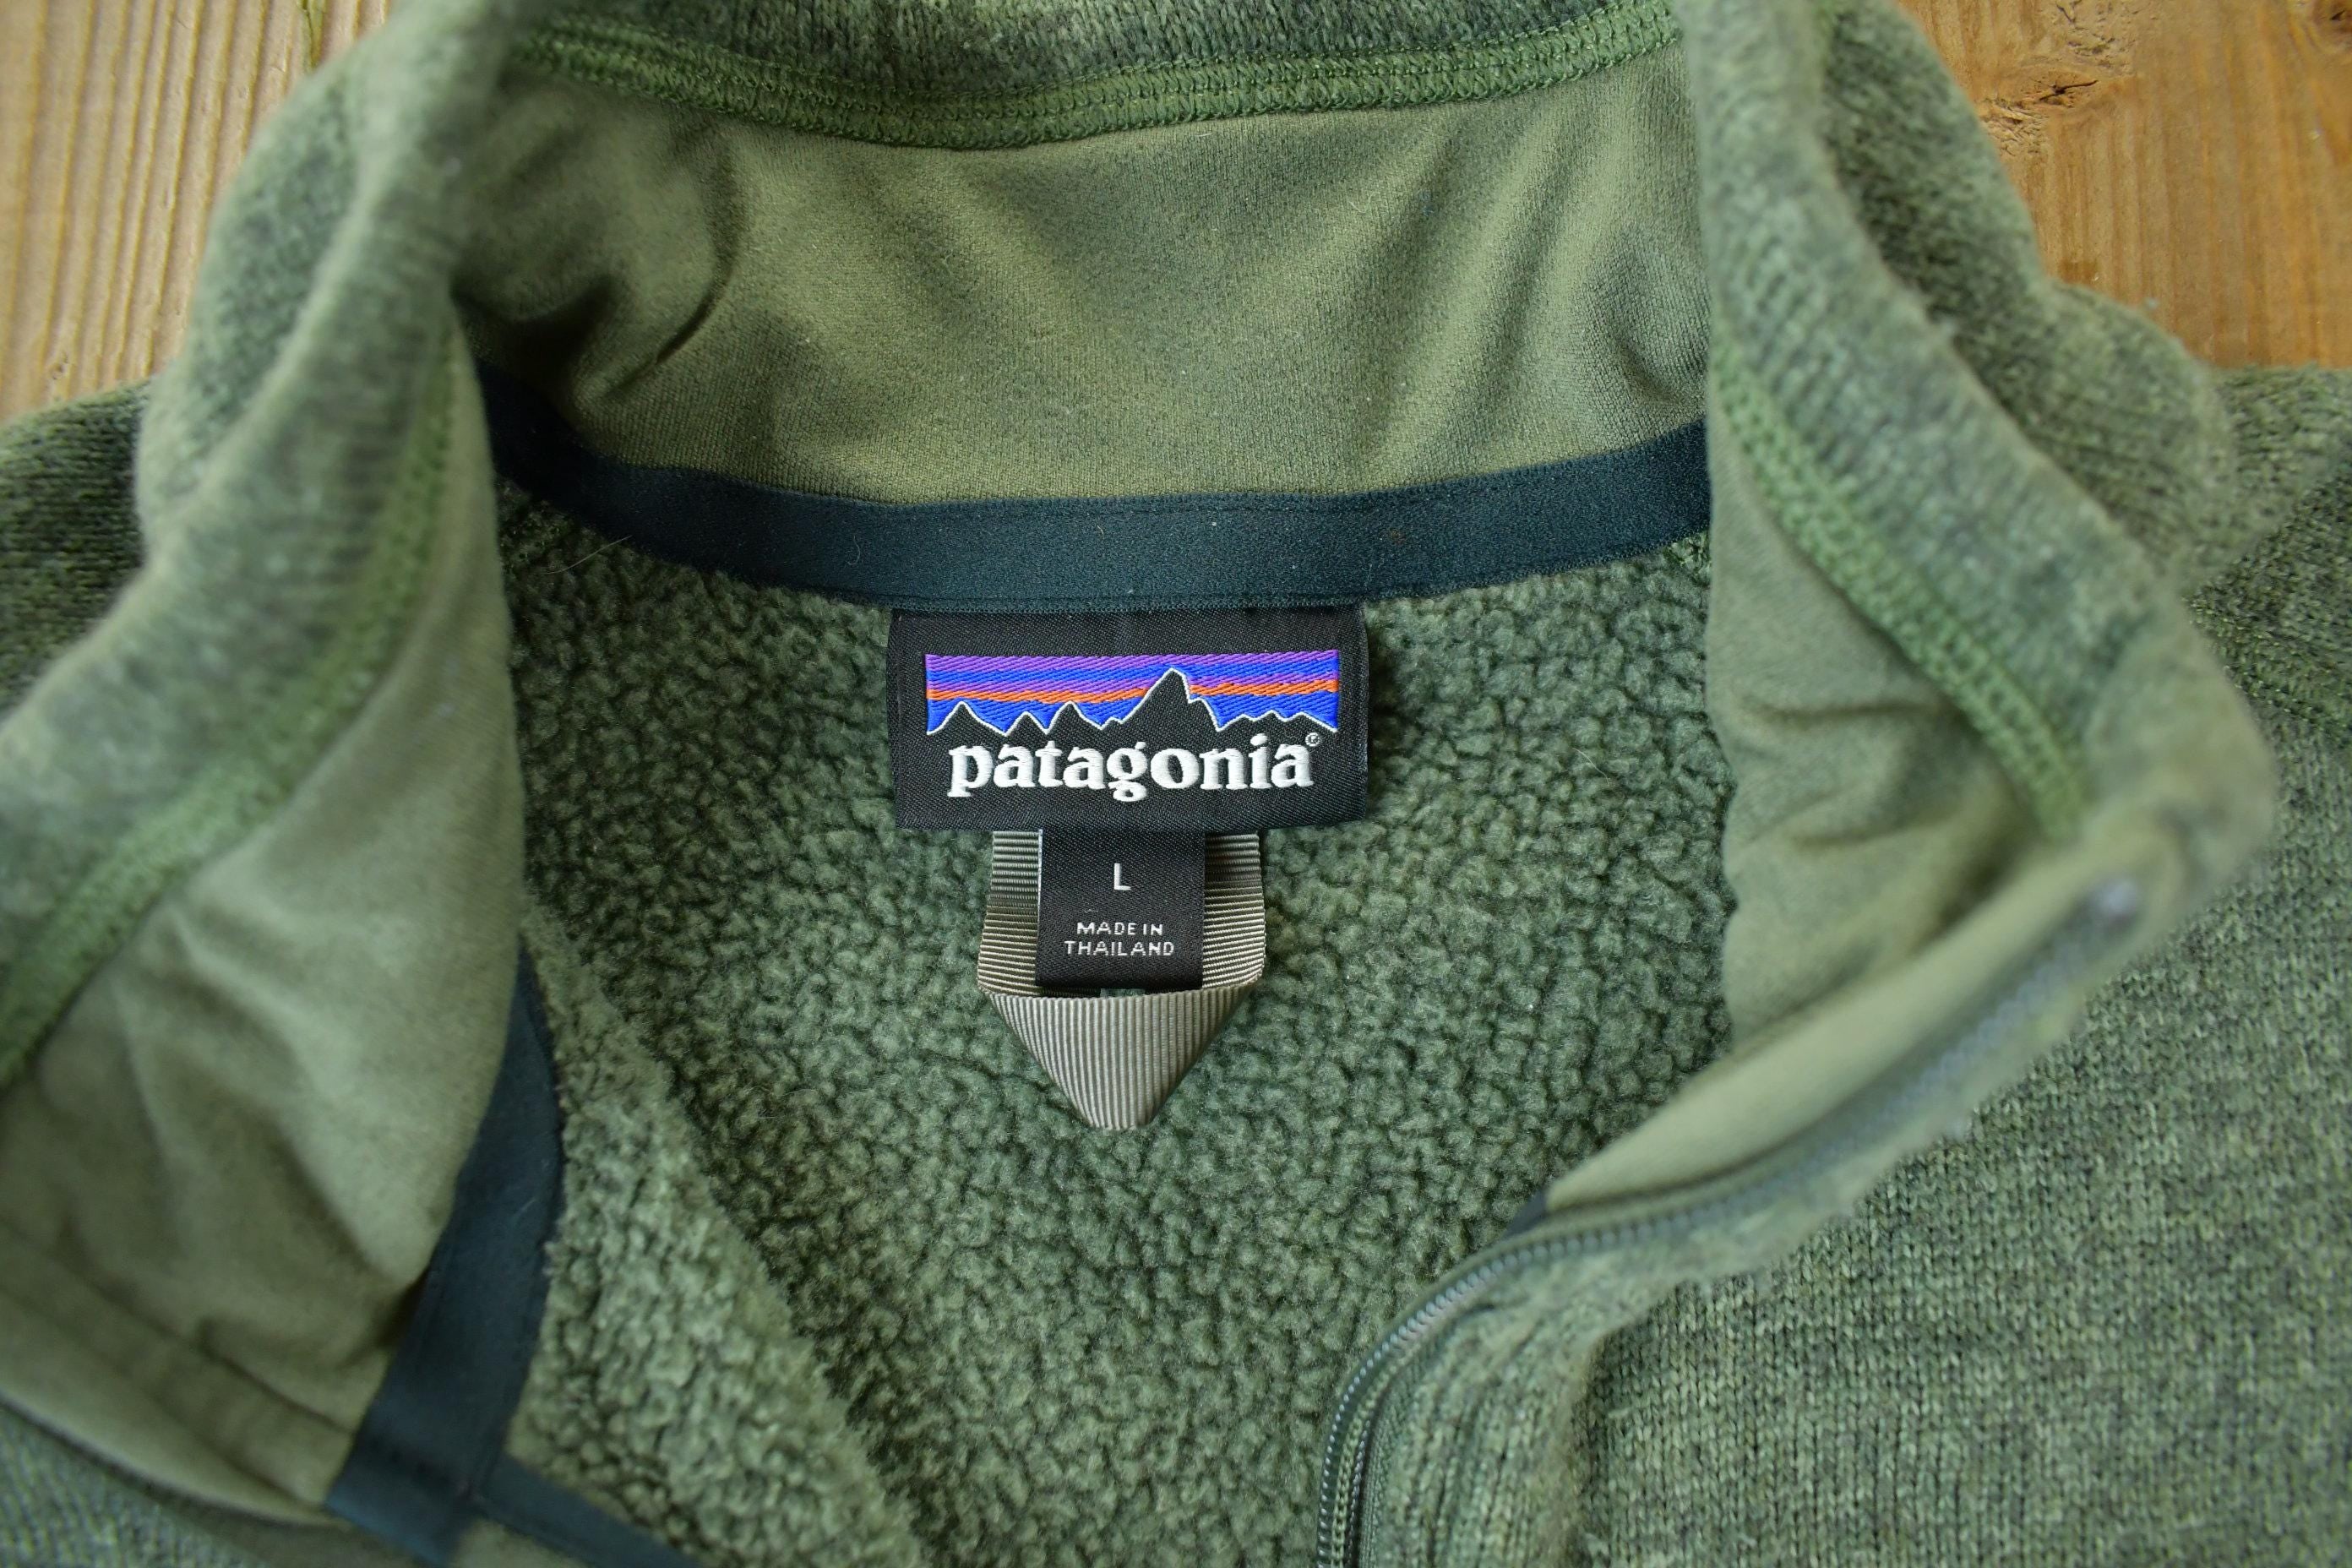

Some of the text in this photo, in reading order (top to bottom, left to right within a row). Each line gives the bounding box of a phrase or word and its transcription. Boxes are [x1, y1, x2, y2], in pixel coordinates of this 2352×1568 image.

[1113, 862, 1132, 891] L
[1075, 921, 1164, 936] MADE IN
[1064, 940, 1175, 956] THAILAND
